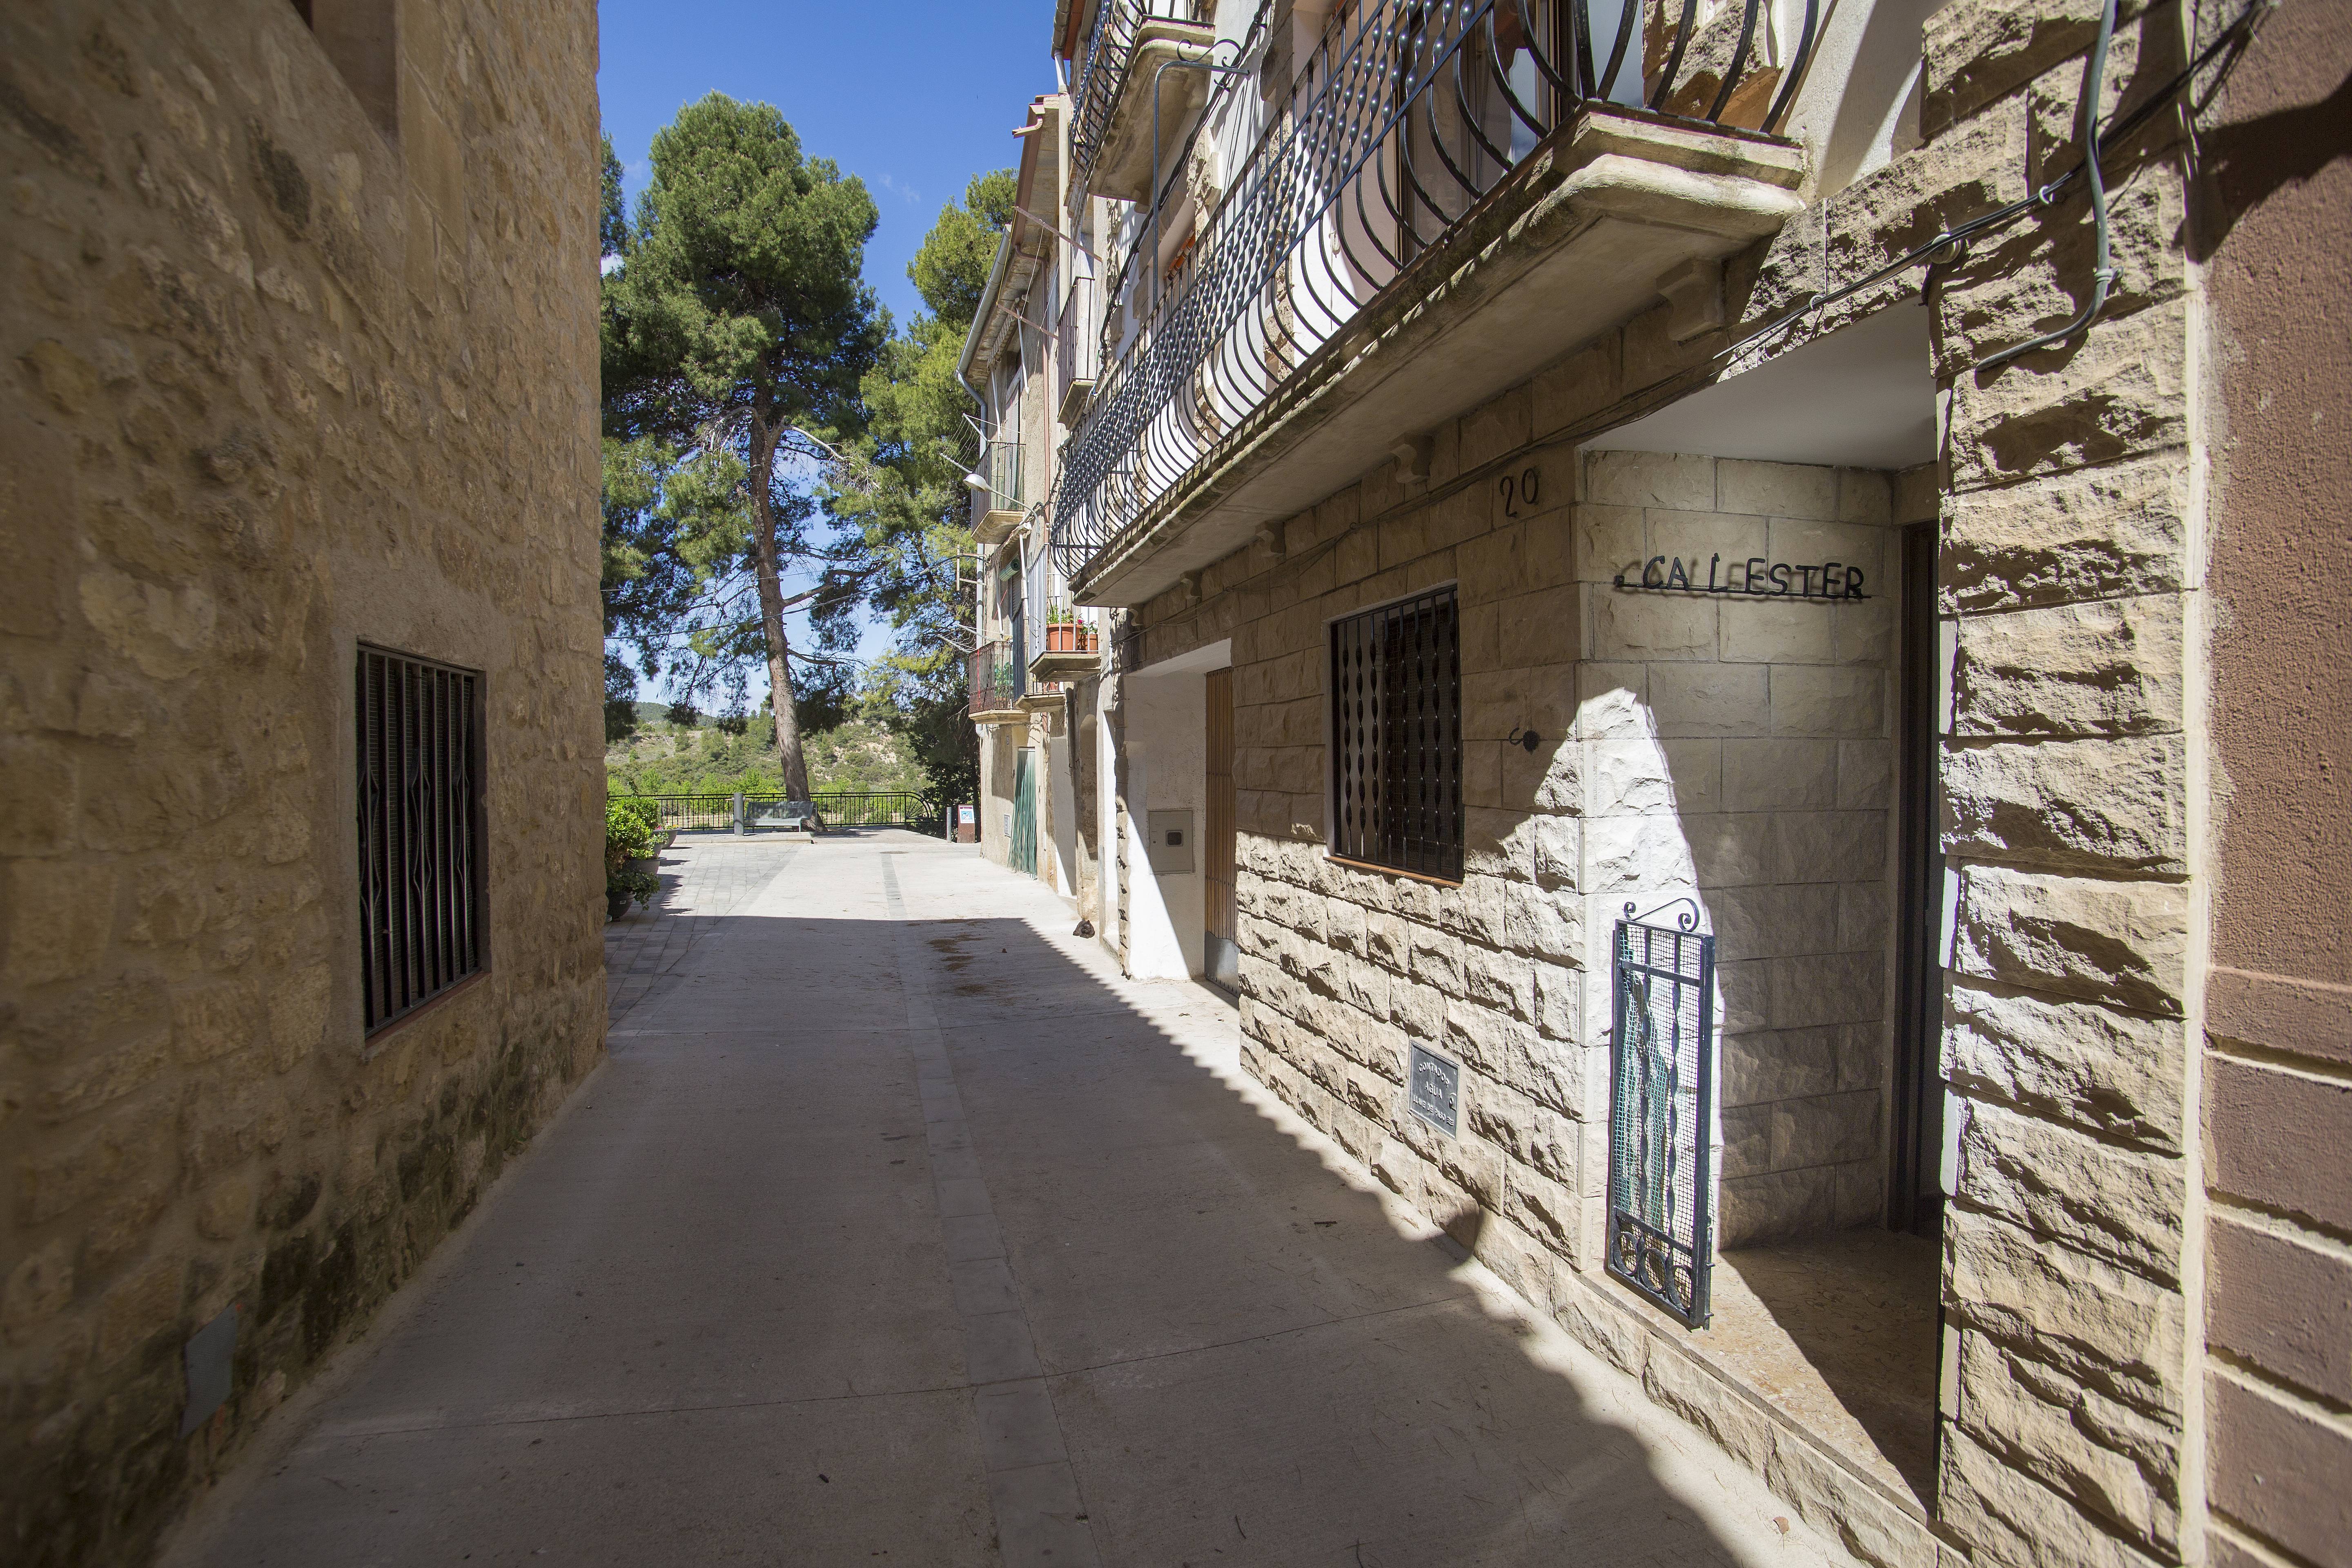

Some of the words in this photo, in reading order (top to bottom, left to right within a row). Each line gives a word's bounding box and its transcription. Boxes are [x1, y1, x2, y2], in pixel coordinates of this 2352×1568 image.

[1499, 468, 1539, 517] 20
[1419, 1062, 1450, 1089] CONTADOR
[1425, 1081, 1442, 1100] AGUA
[1427, 1104, 1434, 1114] DE
[1434, 1107, 1446, 1122] PASO
